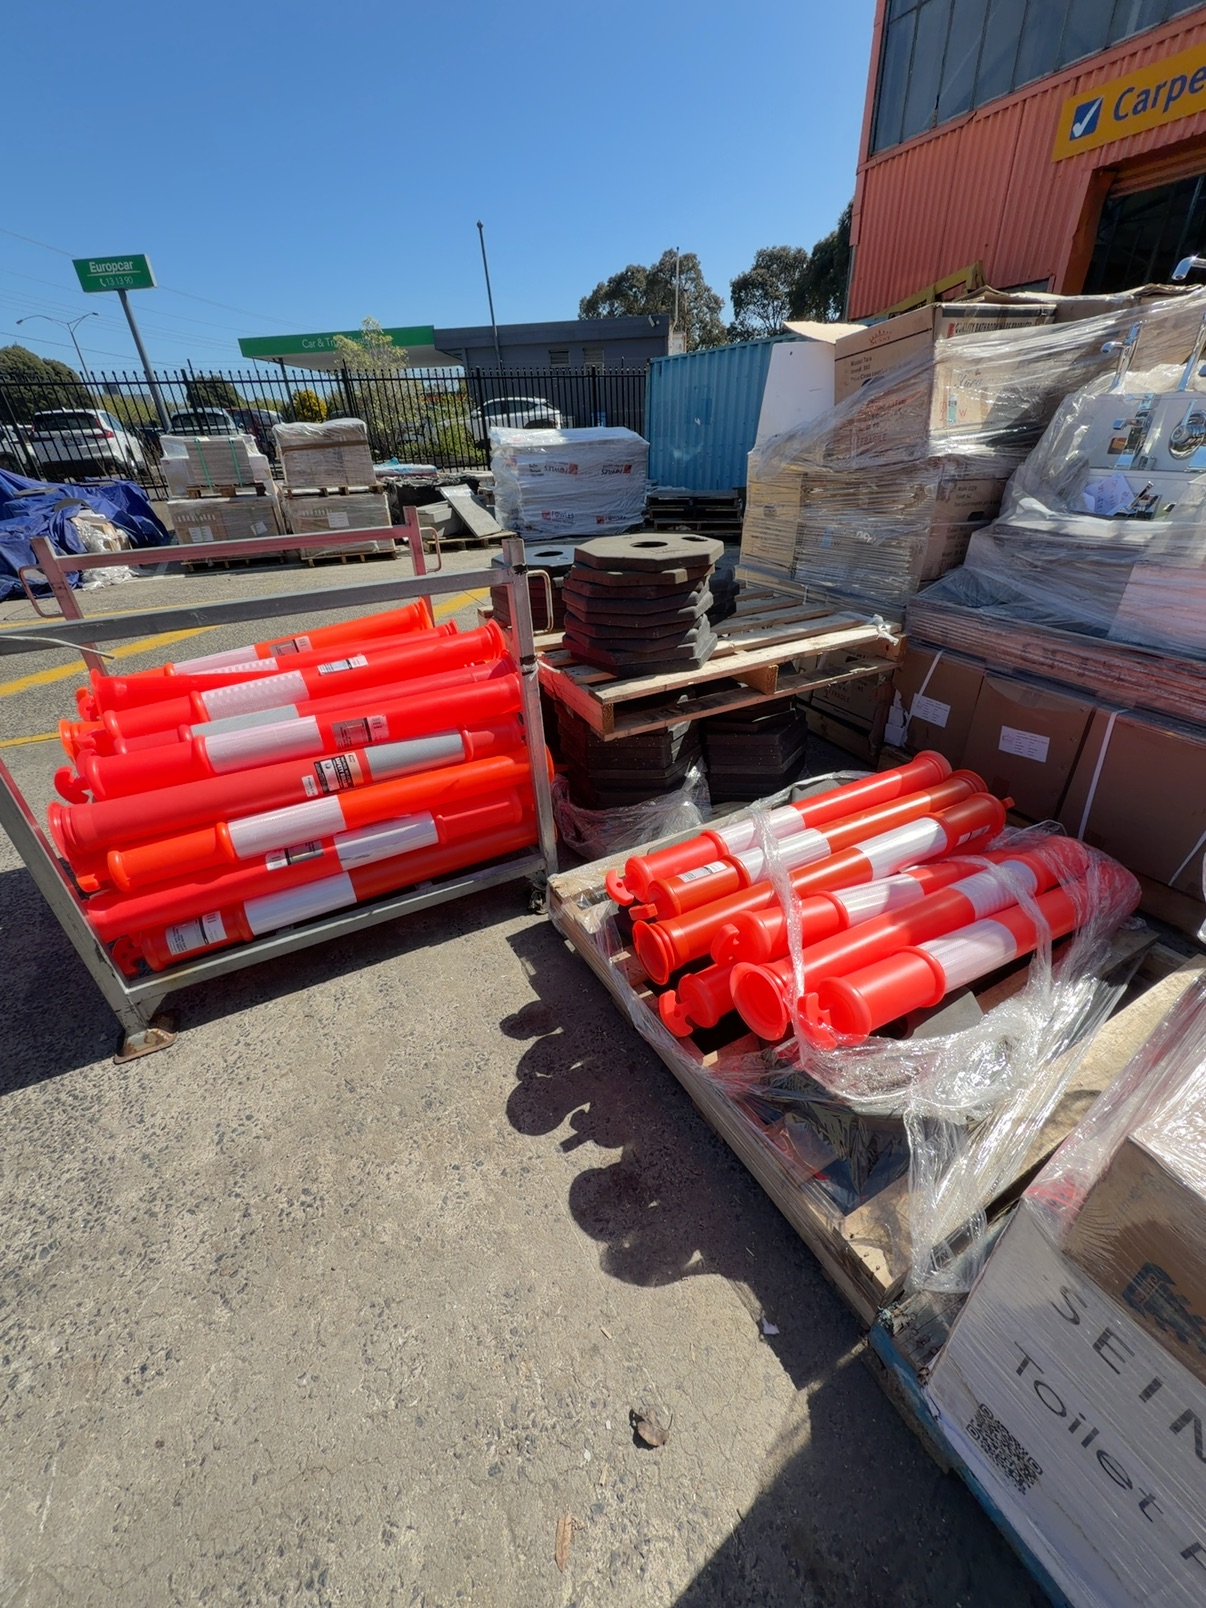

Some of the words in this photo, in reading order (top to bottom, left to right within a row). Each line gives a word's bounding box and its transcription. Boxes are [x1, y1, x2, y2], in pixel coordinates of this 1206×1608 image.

[1113, 66, 1206, 122] Carpe
[88, 261, 133, 274] Europcar
[106, 277, 115, 286] 13
[115, 276, 124, 285] 13
[124, 275, 134, 285] 90
[301, 338, 316, 349] Car
[317, 337, 325, 348] &
[1013, 1340, 1164, 1524] Toilet
